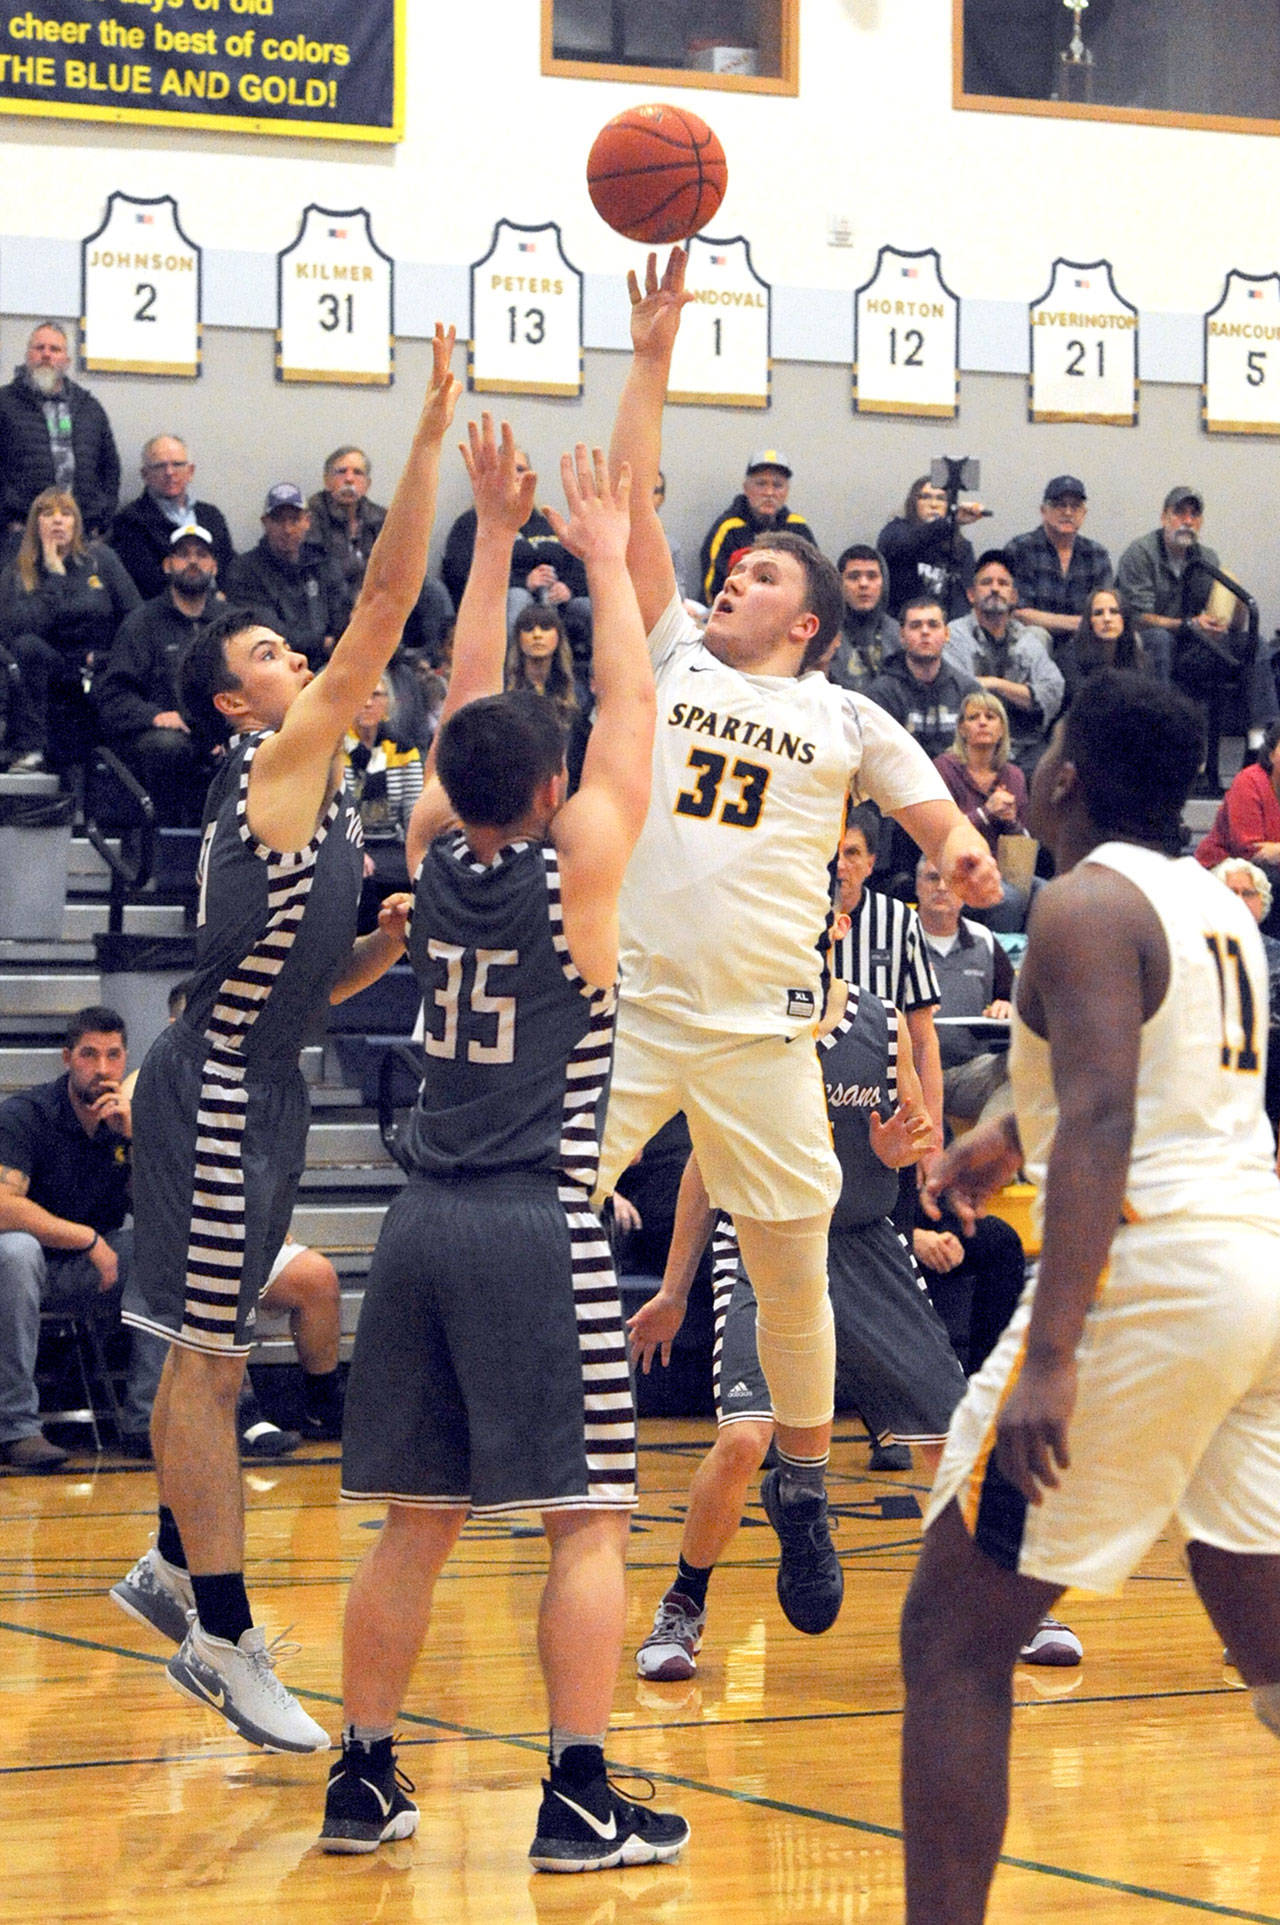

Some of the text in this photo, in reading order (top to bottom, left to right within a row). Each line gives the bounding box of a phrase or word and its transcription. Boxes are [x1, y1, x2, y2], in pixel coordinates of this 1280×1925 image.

[9, 12, 351, 66] cheer the best of colors
[0, 55, 338, 108] THE BLUE AND GOLD!
[91, 250, 195, 273] JOHNSON
[296, 262, 374, 283] KILMER
[133, 283, 159, 323] 2
[491, 274, 565, 296] PETERS
[694, 290, 765, 308] NDOVAL
[318, 293, 354, 334] 31
[508, 305, 546, 345] 13
[867, 298, 945, 318] HORTON
[1029, 311, 1139, 331] LEVERINGTON
[713, 318, 721, 356] 1
[889, 327, 925, 367] 12
[1066, 340, 1104, 378] 21
[1246, 351, 1267, 387] 5
[668, 703, 817, 765] SPARTANS
[673, 746, 772, 831] 33
[425, 938, 519, 1064] 35
[794, 991, 810, 1002] XL
[1203, 932, 1260, 1075] 11
[826, 1082, 881, 1108] sano
